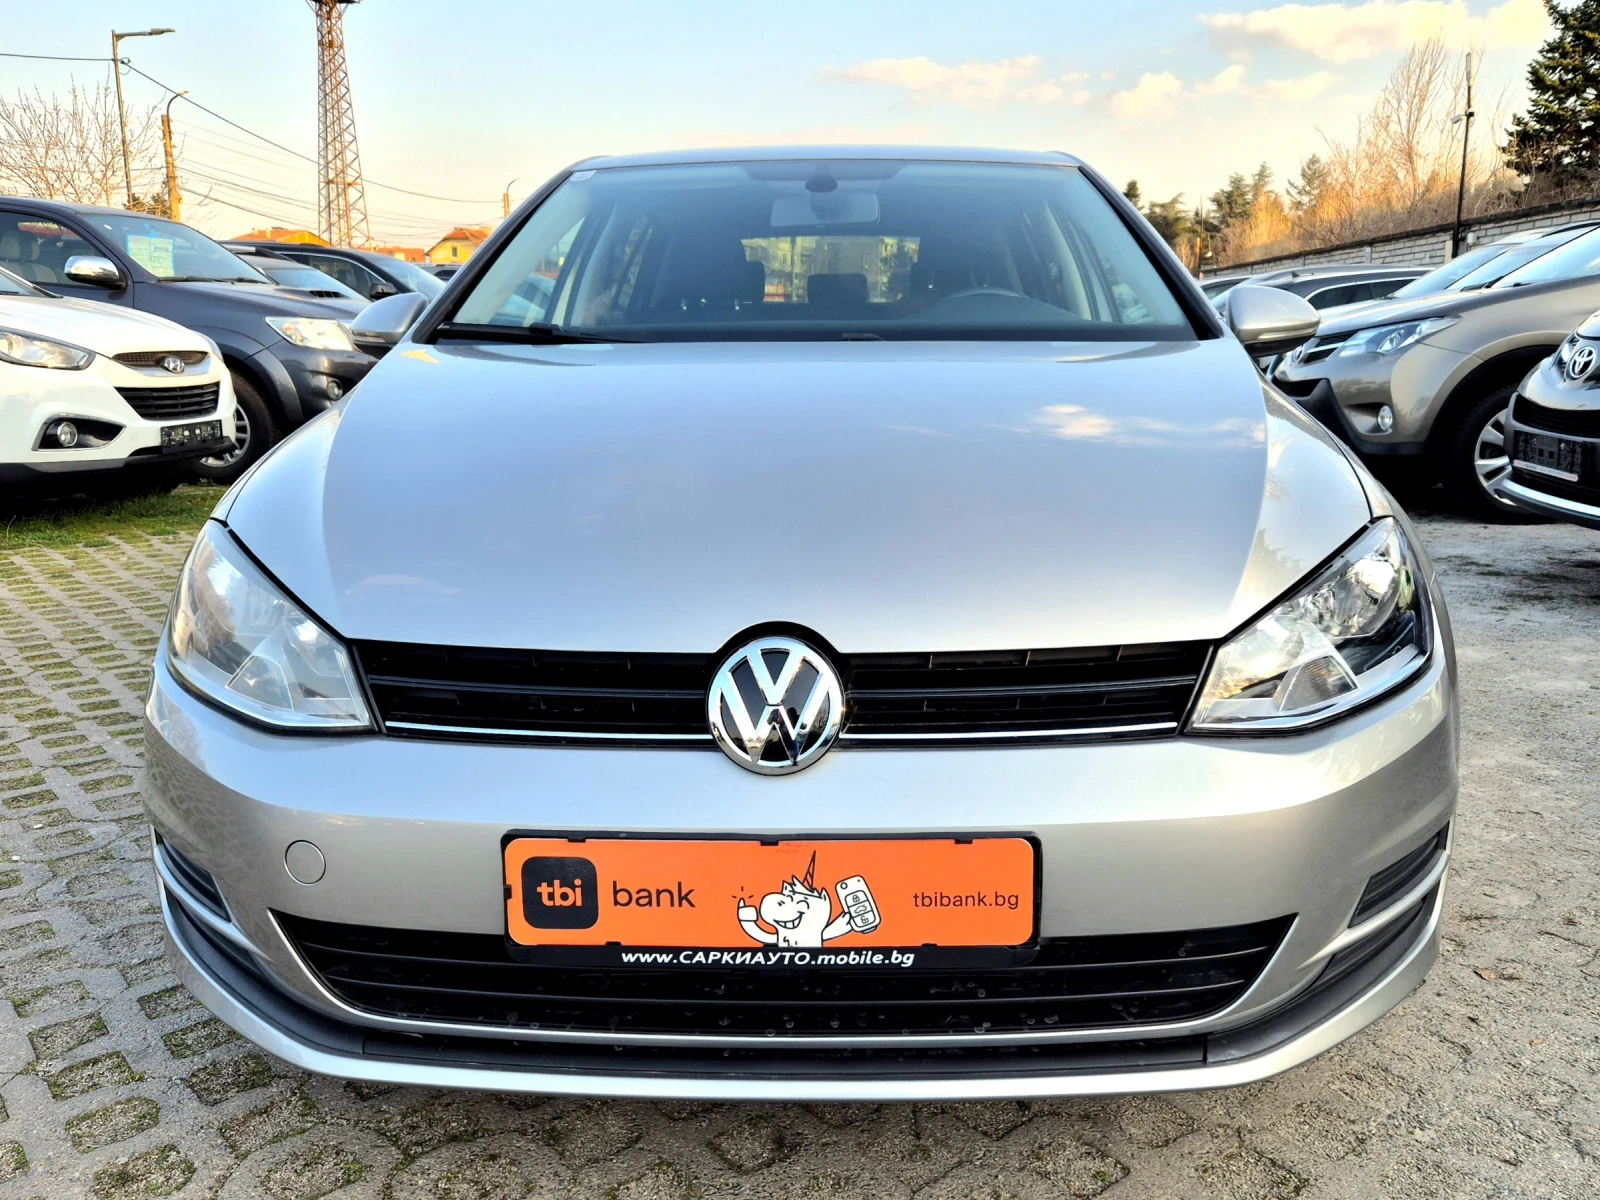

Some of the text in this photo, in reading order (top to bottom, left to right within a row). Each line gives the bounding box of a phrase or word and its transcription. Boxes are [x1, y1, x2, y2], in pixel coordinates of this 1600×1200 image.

[536, 879, 696, 908] tbi bank
[913, 891, 1020, 910] tbibank.bg
